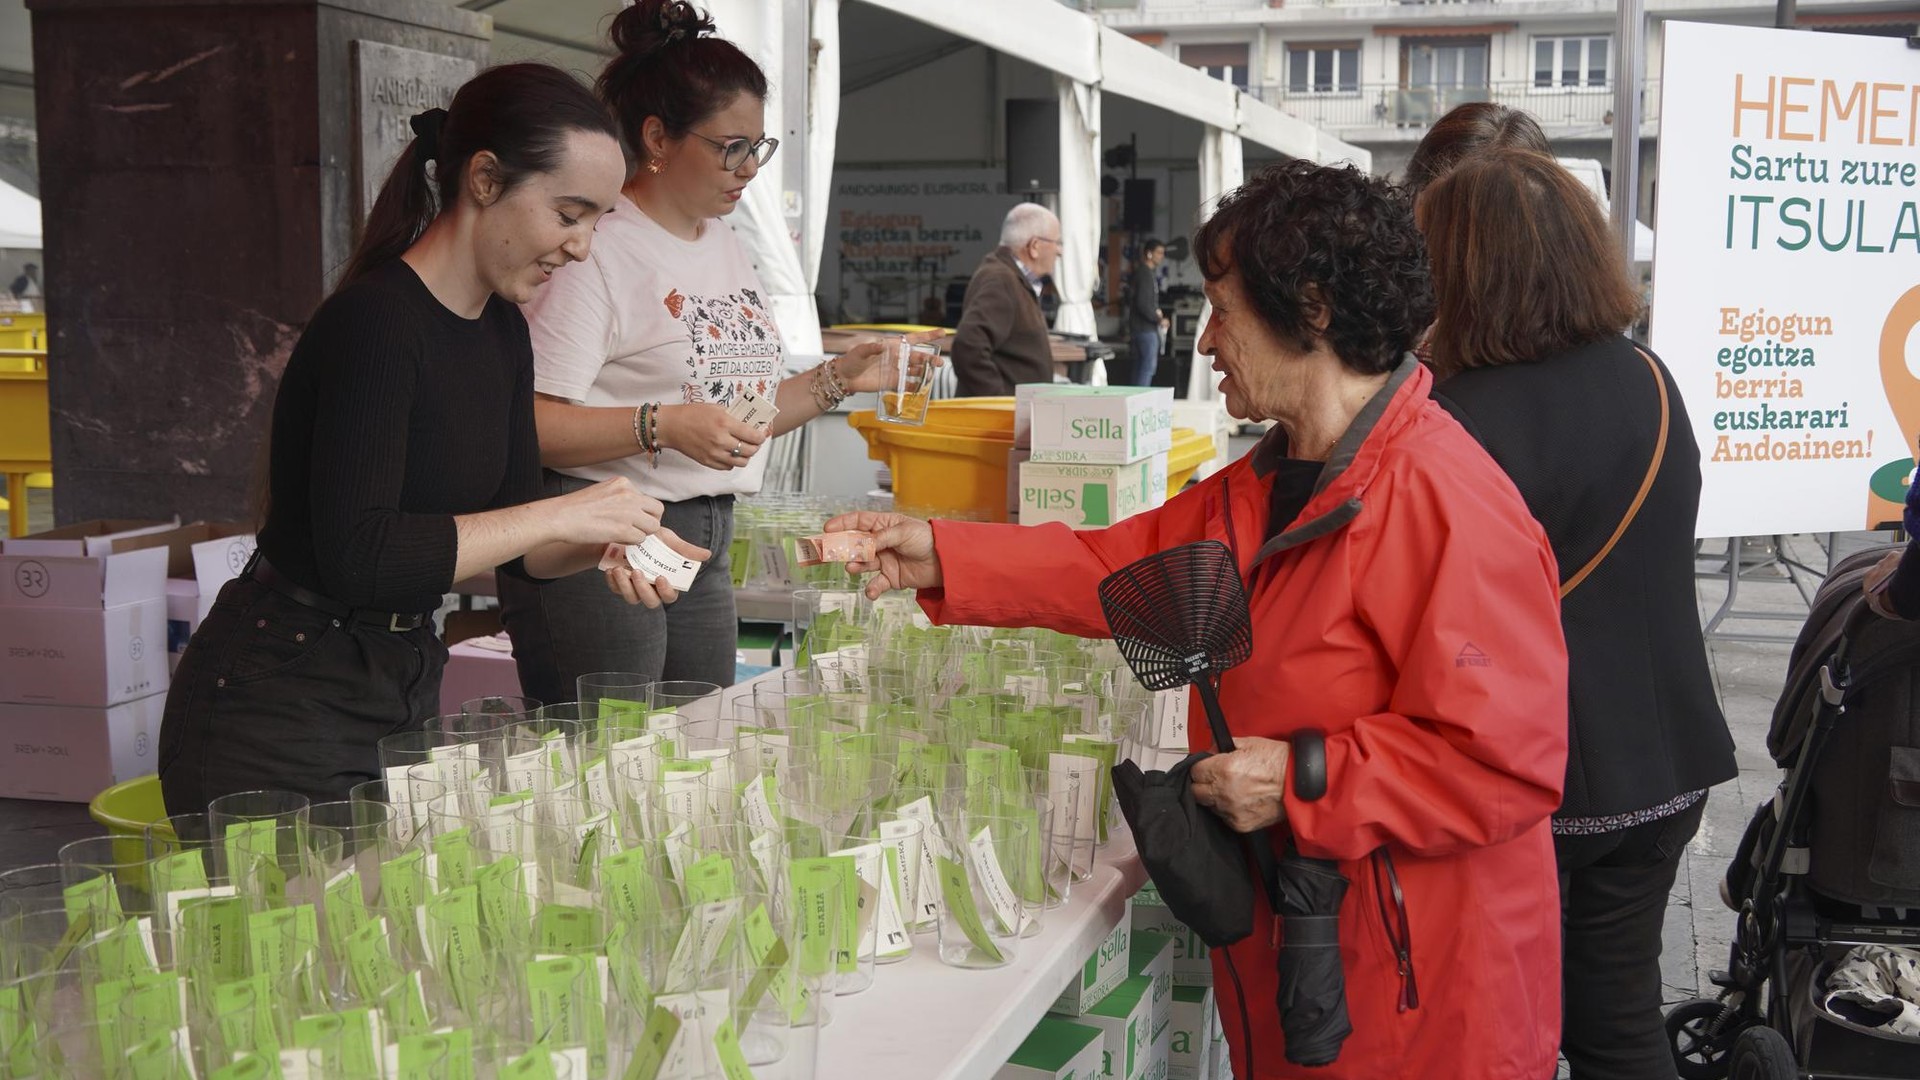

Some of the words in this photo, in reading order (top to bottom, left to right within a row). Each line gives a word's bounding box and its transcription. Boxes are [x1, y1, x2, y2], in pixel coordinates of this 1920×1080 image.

[1729, 144, 1830, 184] Sartu
[1841, 159, 1917, 187] zure
[918, 224, 983, 242] berria
[1725, 194, 1920, 255] ITSULA
[1718, 307, 1833, 343] Egiogun
[708, 343, 739, 357] AMORE
[740, 343, 775, 356] EMATEKO
[1716, 340, 1816, 375] egoitza
[709, 361, 729, 375] BETI
[1715, 371, 1804, 400] berria
[1070, 418, 1123, 440] Sella
[1713, 402, 1849, 432] euskarari
[1056, 452, 1087, 461] SIDRA
[1711, 430, 1874, 463] Andoainen!
[1057, 467, 1088, 476] SIDRA
[1024, 487, 1076, 510] Sella
[815, 892, 825, 937] EDARIA
[1161, 922, 1187, 933] Vaso
[1100, 927, 1127, 968] Sella
